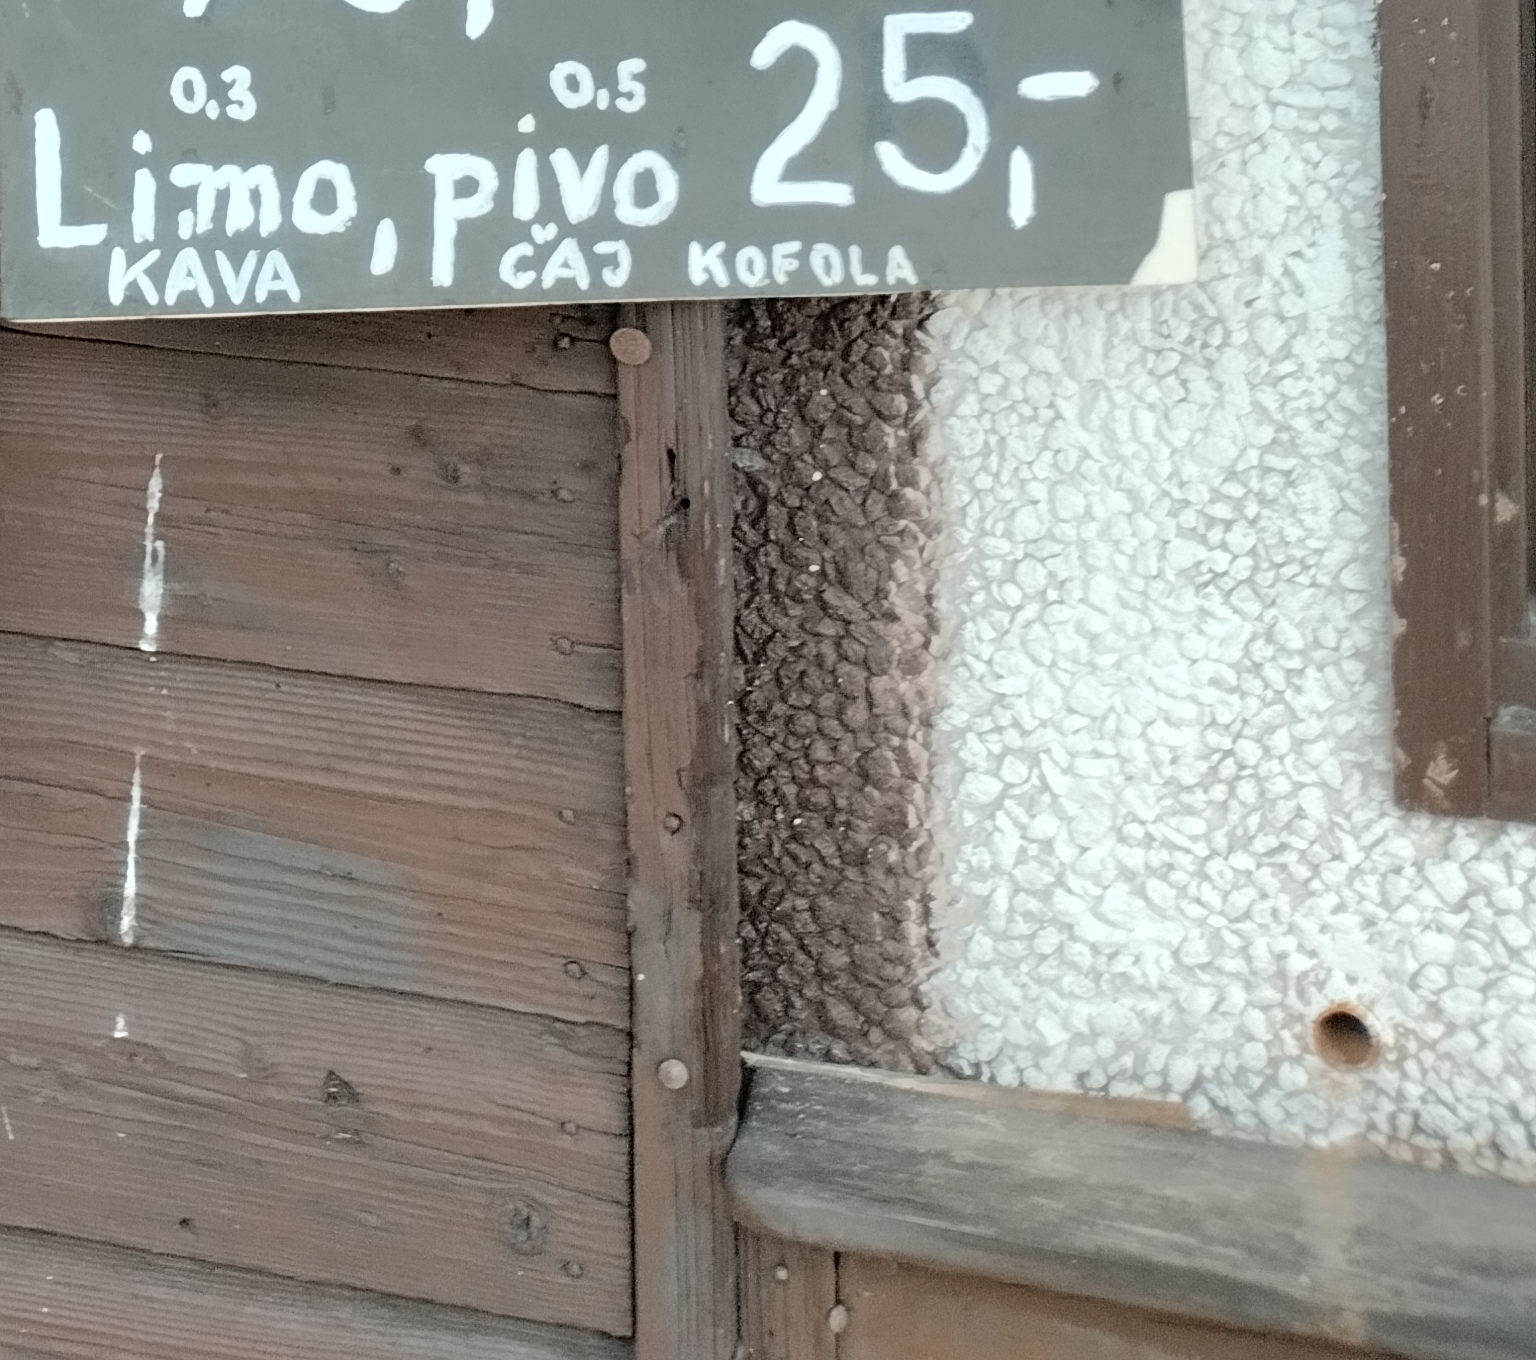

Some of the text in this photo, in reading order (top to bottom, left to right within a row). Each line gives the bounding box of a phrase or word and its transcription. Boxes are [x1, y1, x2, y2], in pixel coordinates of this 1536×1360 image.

[422, 112, 682, 289] pivo
[498, 221, 633, 292] ČAJ
[686, 239, 920, 290] KOFOLA
